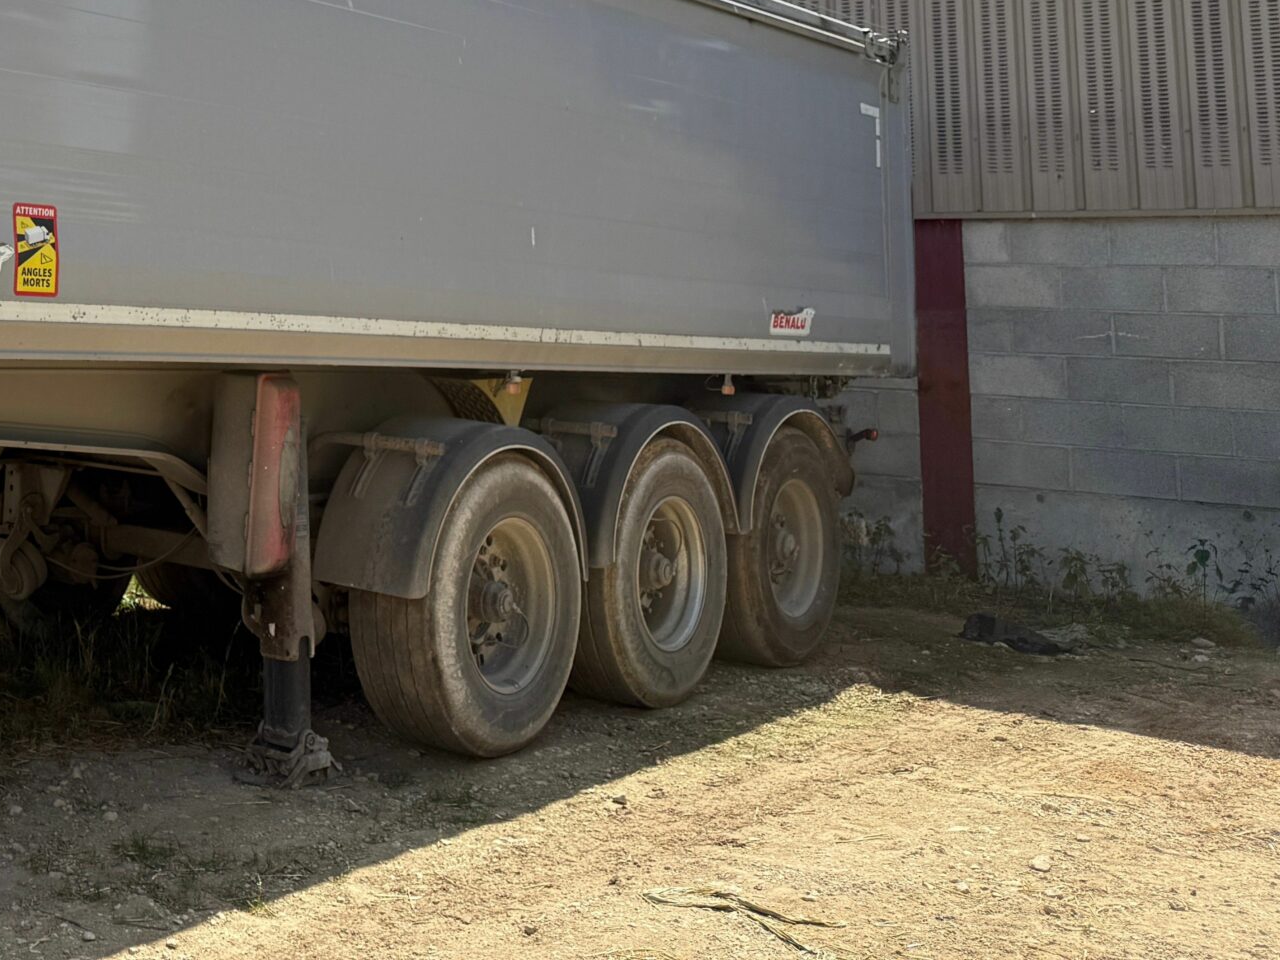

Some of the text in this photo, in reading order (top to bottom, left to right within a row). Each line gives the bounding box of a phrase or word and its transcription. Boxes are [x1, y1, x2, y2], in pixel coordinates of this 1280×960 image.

[16, 205, 55, 217] ATTENTION
[21, 267, 52, 278] ANGLES
[22, 278, 51, 288] MORTS
[773, 314, 807, 330] BENALU
